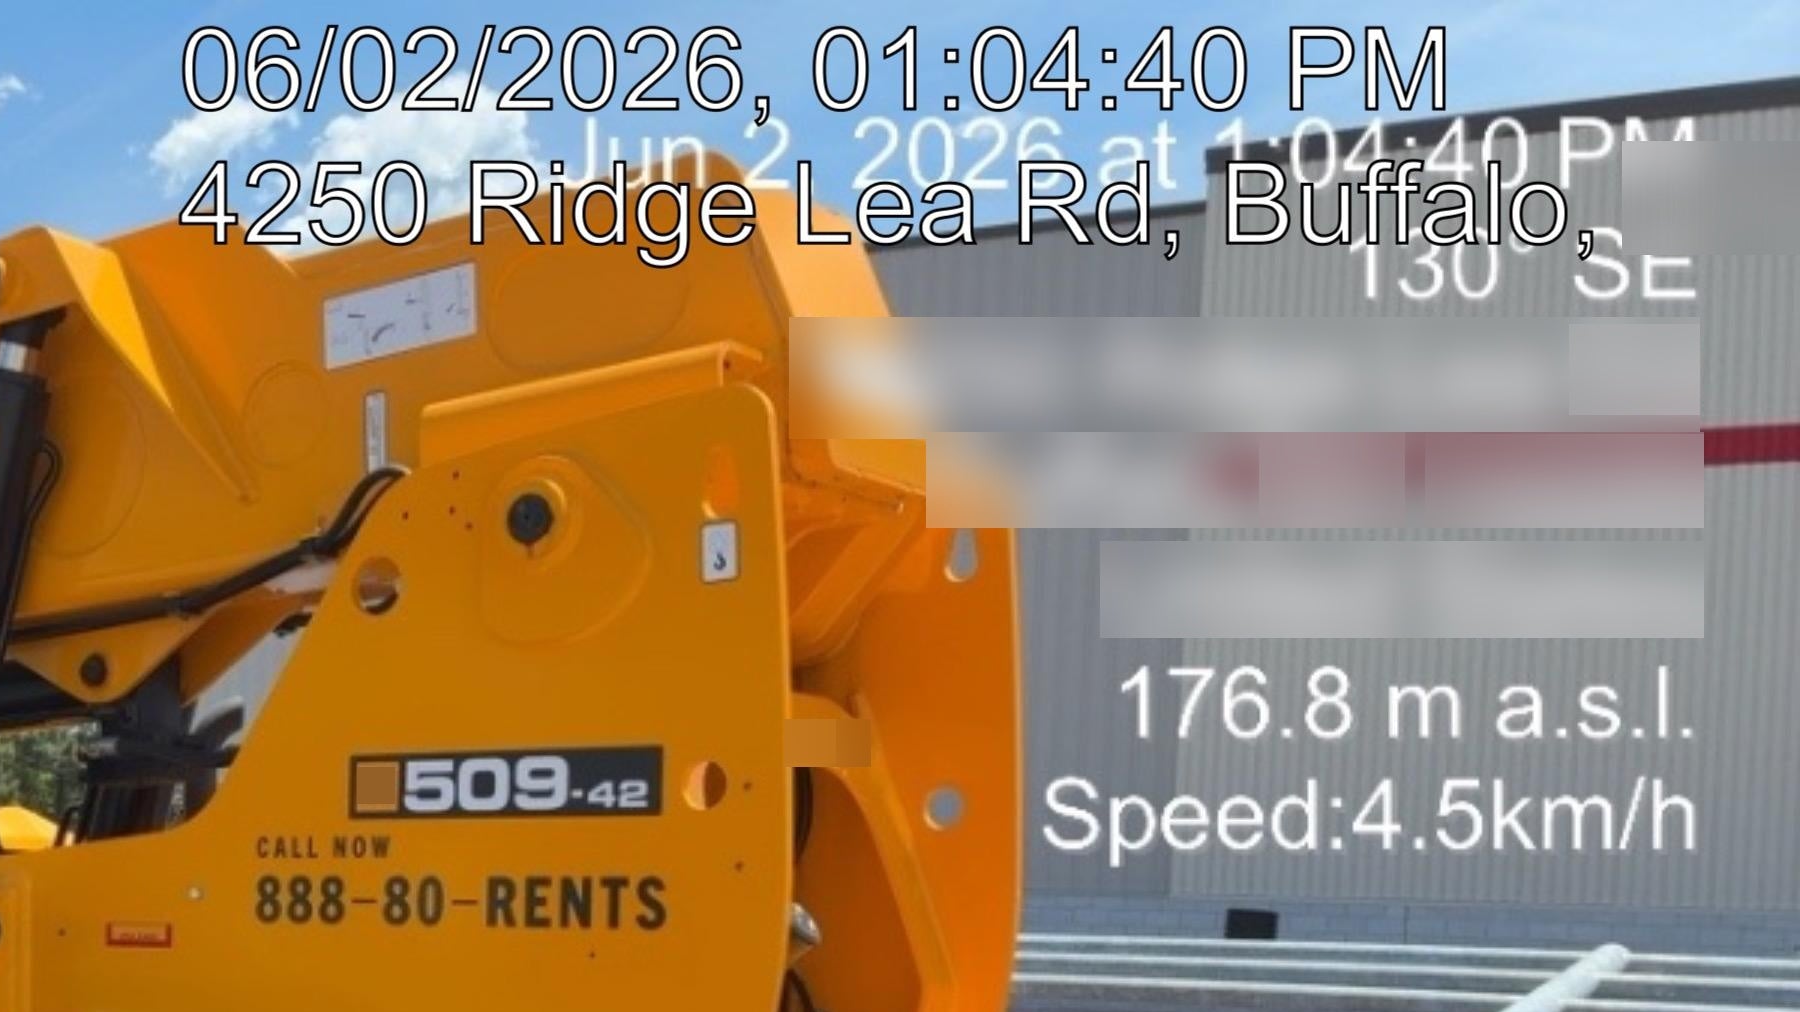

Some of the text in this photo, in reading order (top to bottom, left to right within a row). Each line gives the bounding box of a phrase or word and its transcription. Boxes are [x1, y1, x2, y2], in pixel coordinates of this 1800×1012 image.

[402, 754, 650, 814] 509-42
[255, 835, 392, 860] CALL NOW
[255, 874, 669, 931] 888-80-RENTS
